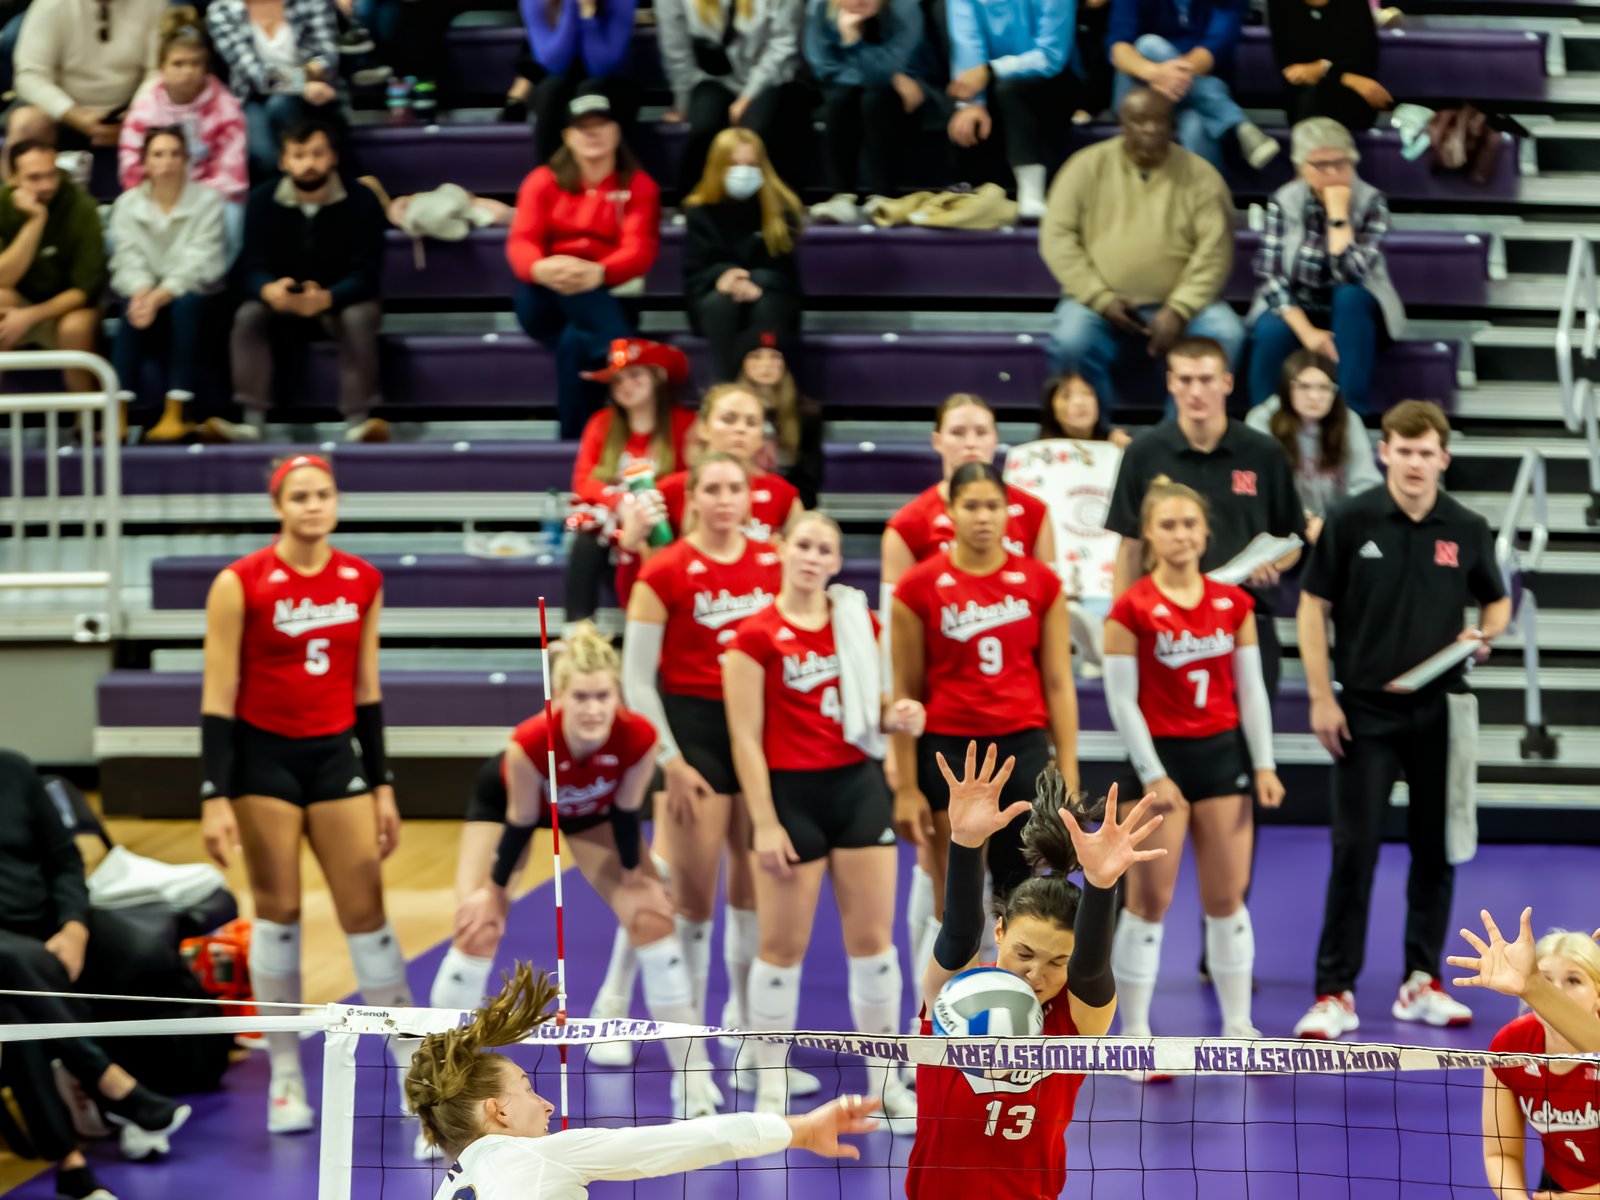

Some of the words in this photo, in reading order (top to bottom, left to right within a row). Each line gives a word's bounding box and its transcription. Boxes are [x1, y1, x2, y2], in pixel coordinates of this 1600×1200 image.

[304, 638, 331, 676] 5
[977, 636, 1003, 676] 9
[1187, 669, 1210, 708] 7
[356, 1010, 390, 1018] Senoh
[946, 1044, 1156, 1071] NORTHWESTERN
[1194, 1046, 1403, 1072] NORTHWESTERN
[984, 1099, 1037, 1141] 13
[1519, 1095, 1600, 1134] Nebrask
[1564, 1138, 1586, 1163] 1
